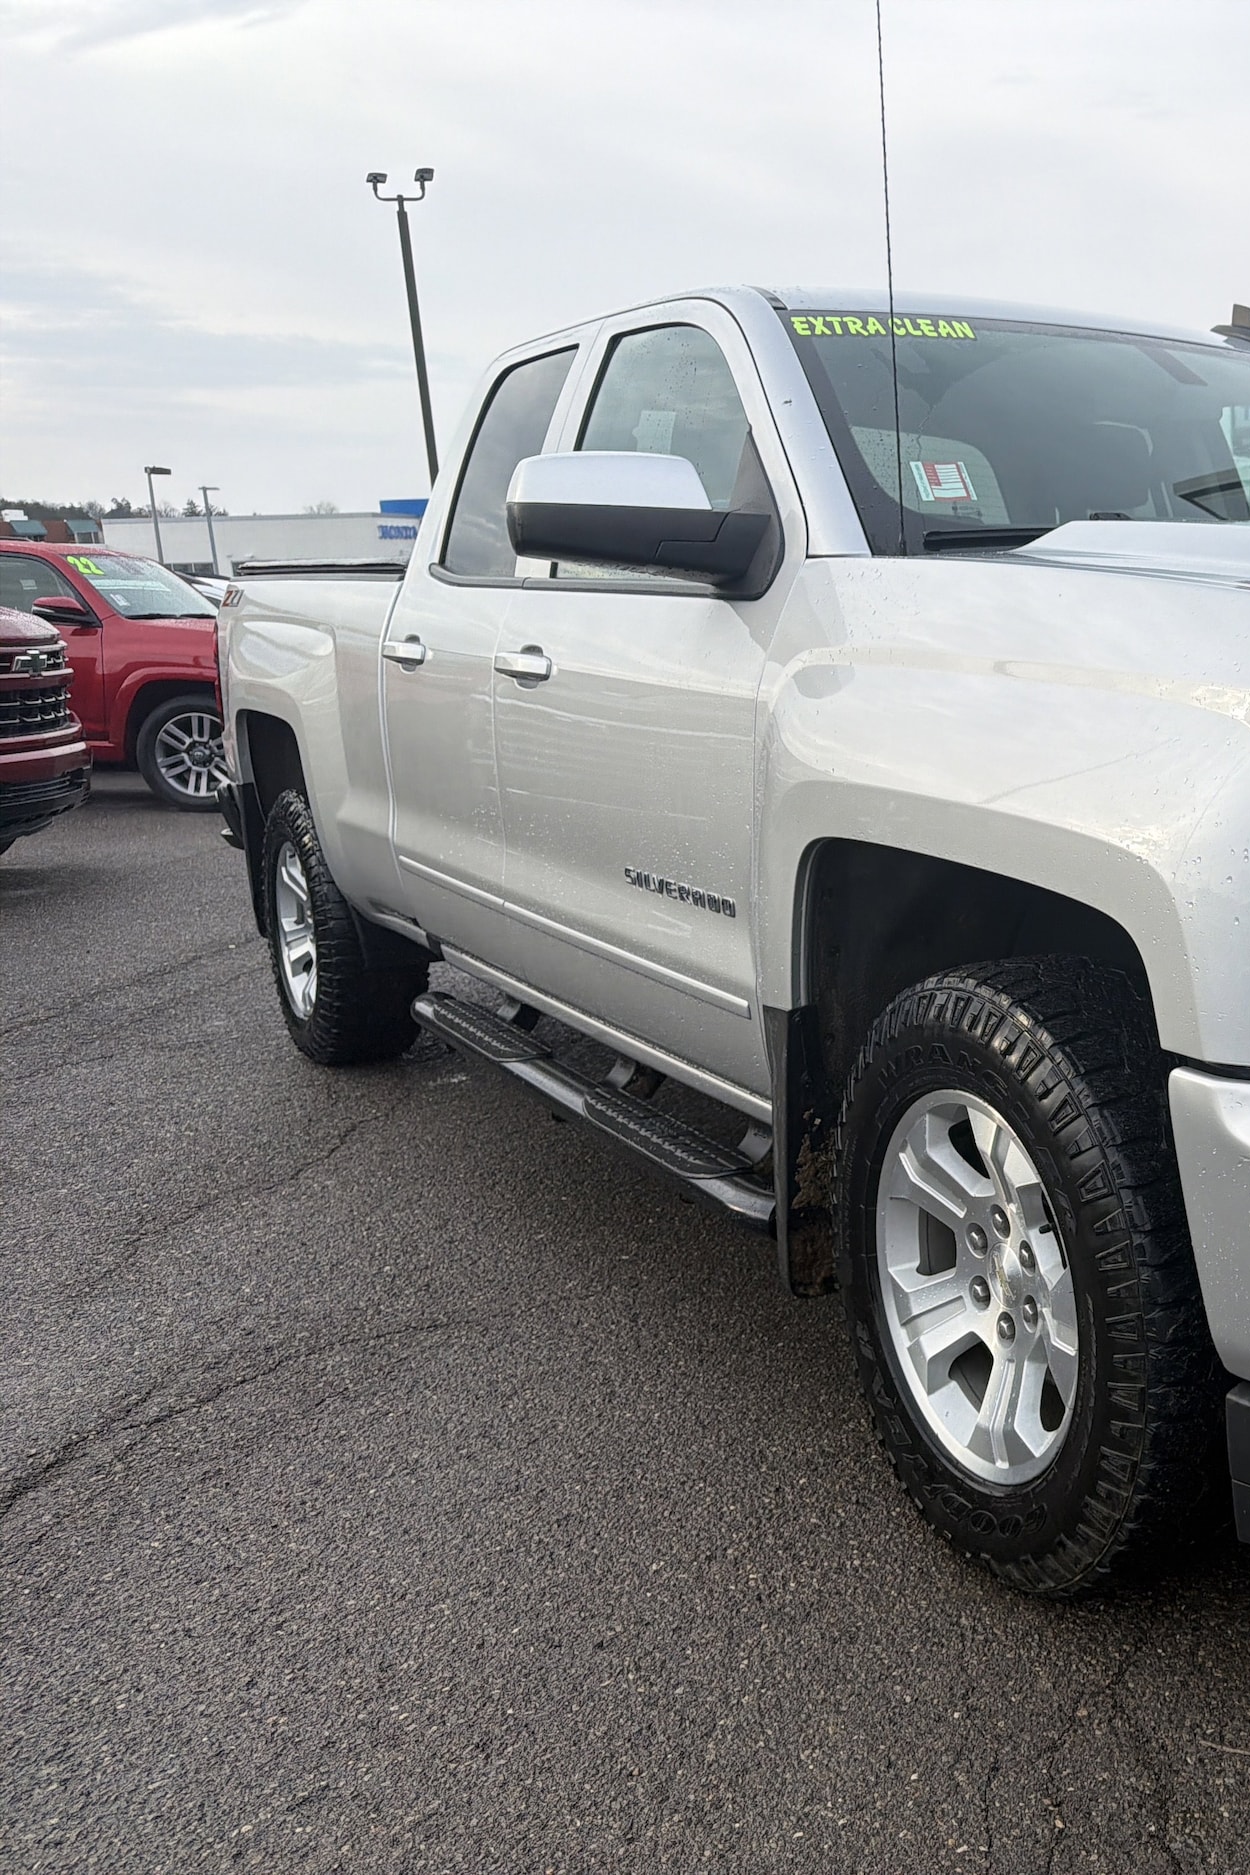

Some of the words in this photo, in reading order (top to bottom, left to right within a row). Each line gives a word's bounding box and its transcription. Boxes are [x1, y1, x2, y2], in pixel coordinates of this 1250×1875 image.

[790, 316, 886, 336] EXTRA
[888, 318, 976, 338] CLEAN
[66, 555, 105, 576] 22
[624, 866, 736, 918] SILVERADO
